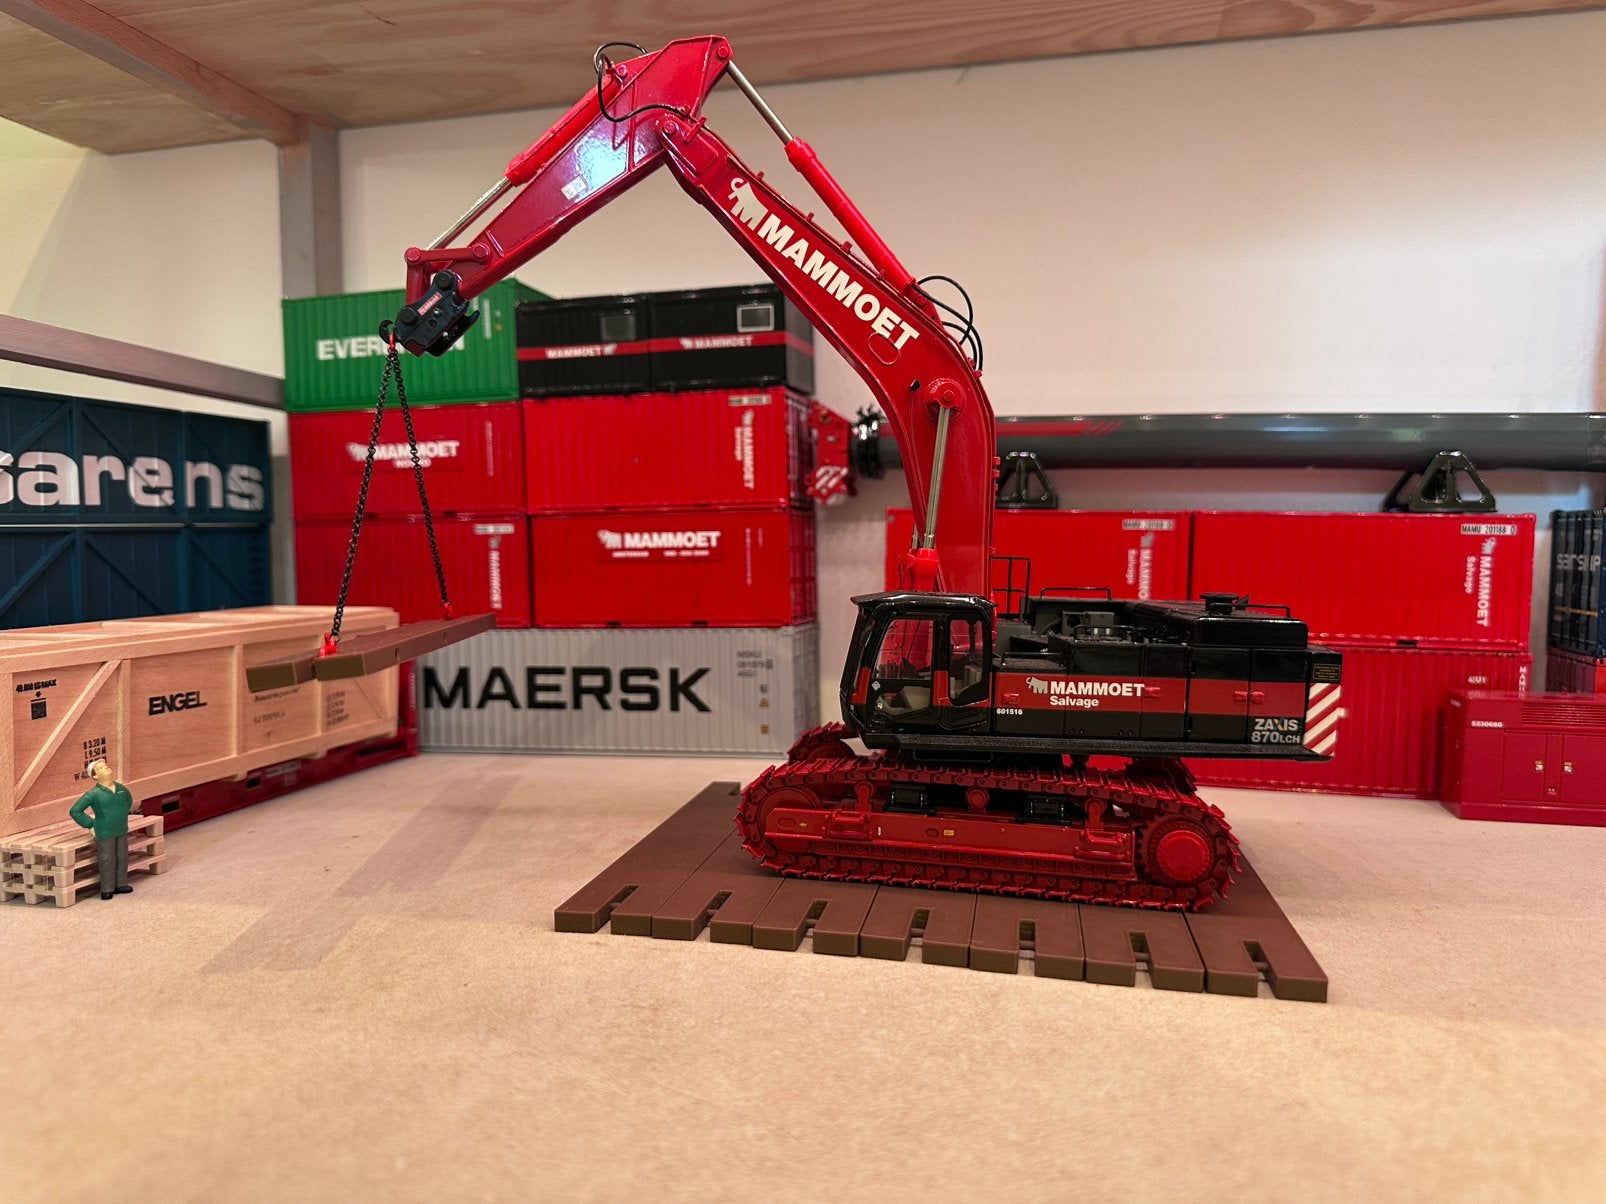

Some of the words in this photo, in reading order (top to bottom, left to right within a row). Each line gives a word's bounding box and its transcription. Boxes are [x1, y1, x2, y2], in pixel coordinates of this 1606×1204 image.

[757, 213, 920, 351] MAMMOET
[694, 336, 754, 349] MAMMOET
[545, 344, 603, 359] MAMMOET
[1462, 525, 1481, 533] MAMU
[624, 531, 721, 548] MAMMOET
[1138, 549, 1152, 600] MAMMO
[1464, 556, 1476, 594] Salvage
[1476, 556, 1492, 627] MAMMOET
[422, 666, 712, 711] MAERSK
[1050, 681, 1145, 696] MAMMOET
[149, 691, 208, 715] ENGEL
[1050, 696, 1099, 708] Salvage
[1254, 718, 1298, 731] ZAXIS
